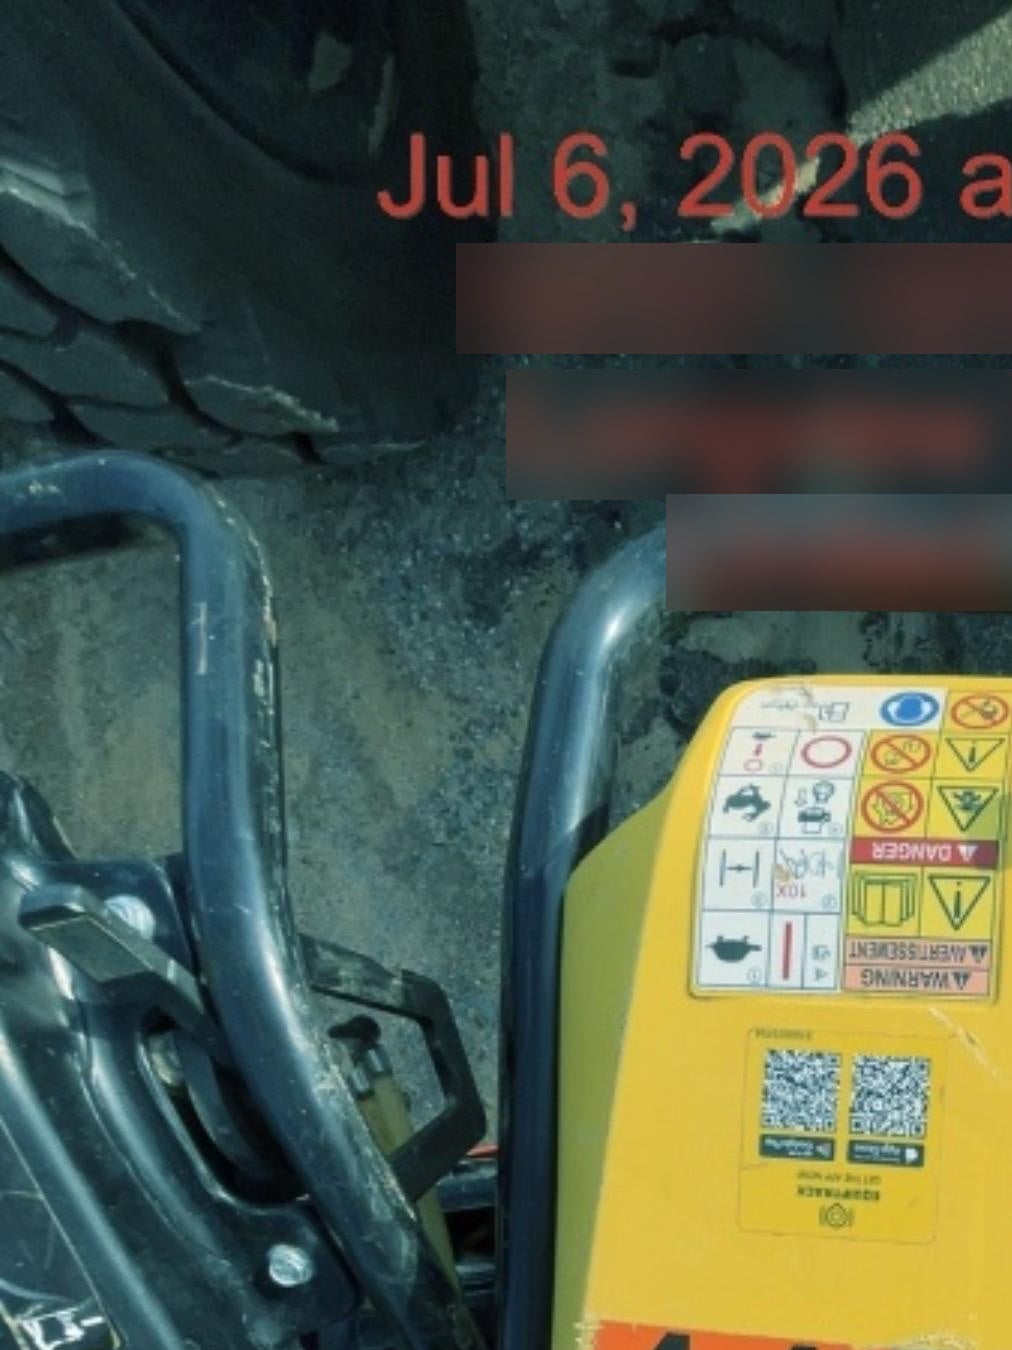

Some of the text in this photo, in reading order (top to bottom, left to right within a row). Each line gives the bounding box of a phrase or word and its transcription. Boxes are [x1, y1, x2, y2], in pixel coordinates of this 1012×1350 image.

[872, 841, 952, 862] DANGER
[776, 883, 807, 899] 10X
[849, 940, 966, 962] AVERTISSEMENT
[860, 967, 949, 990] WARNING
